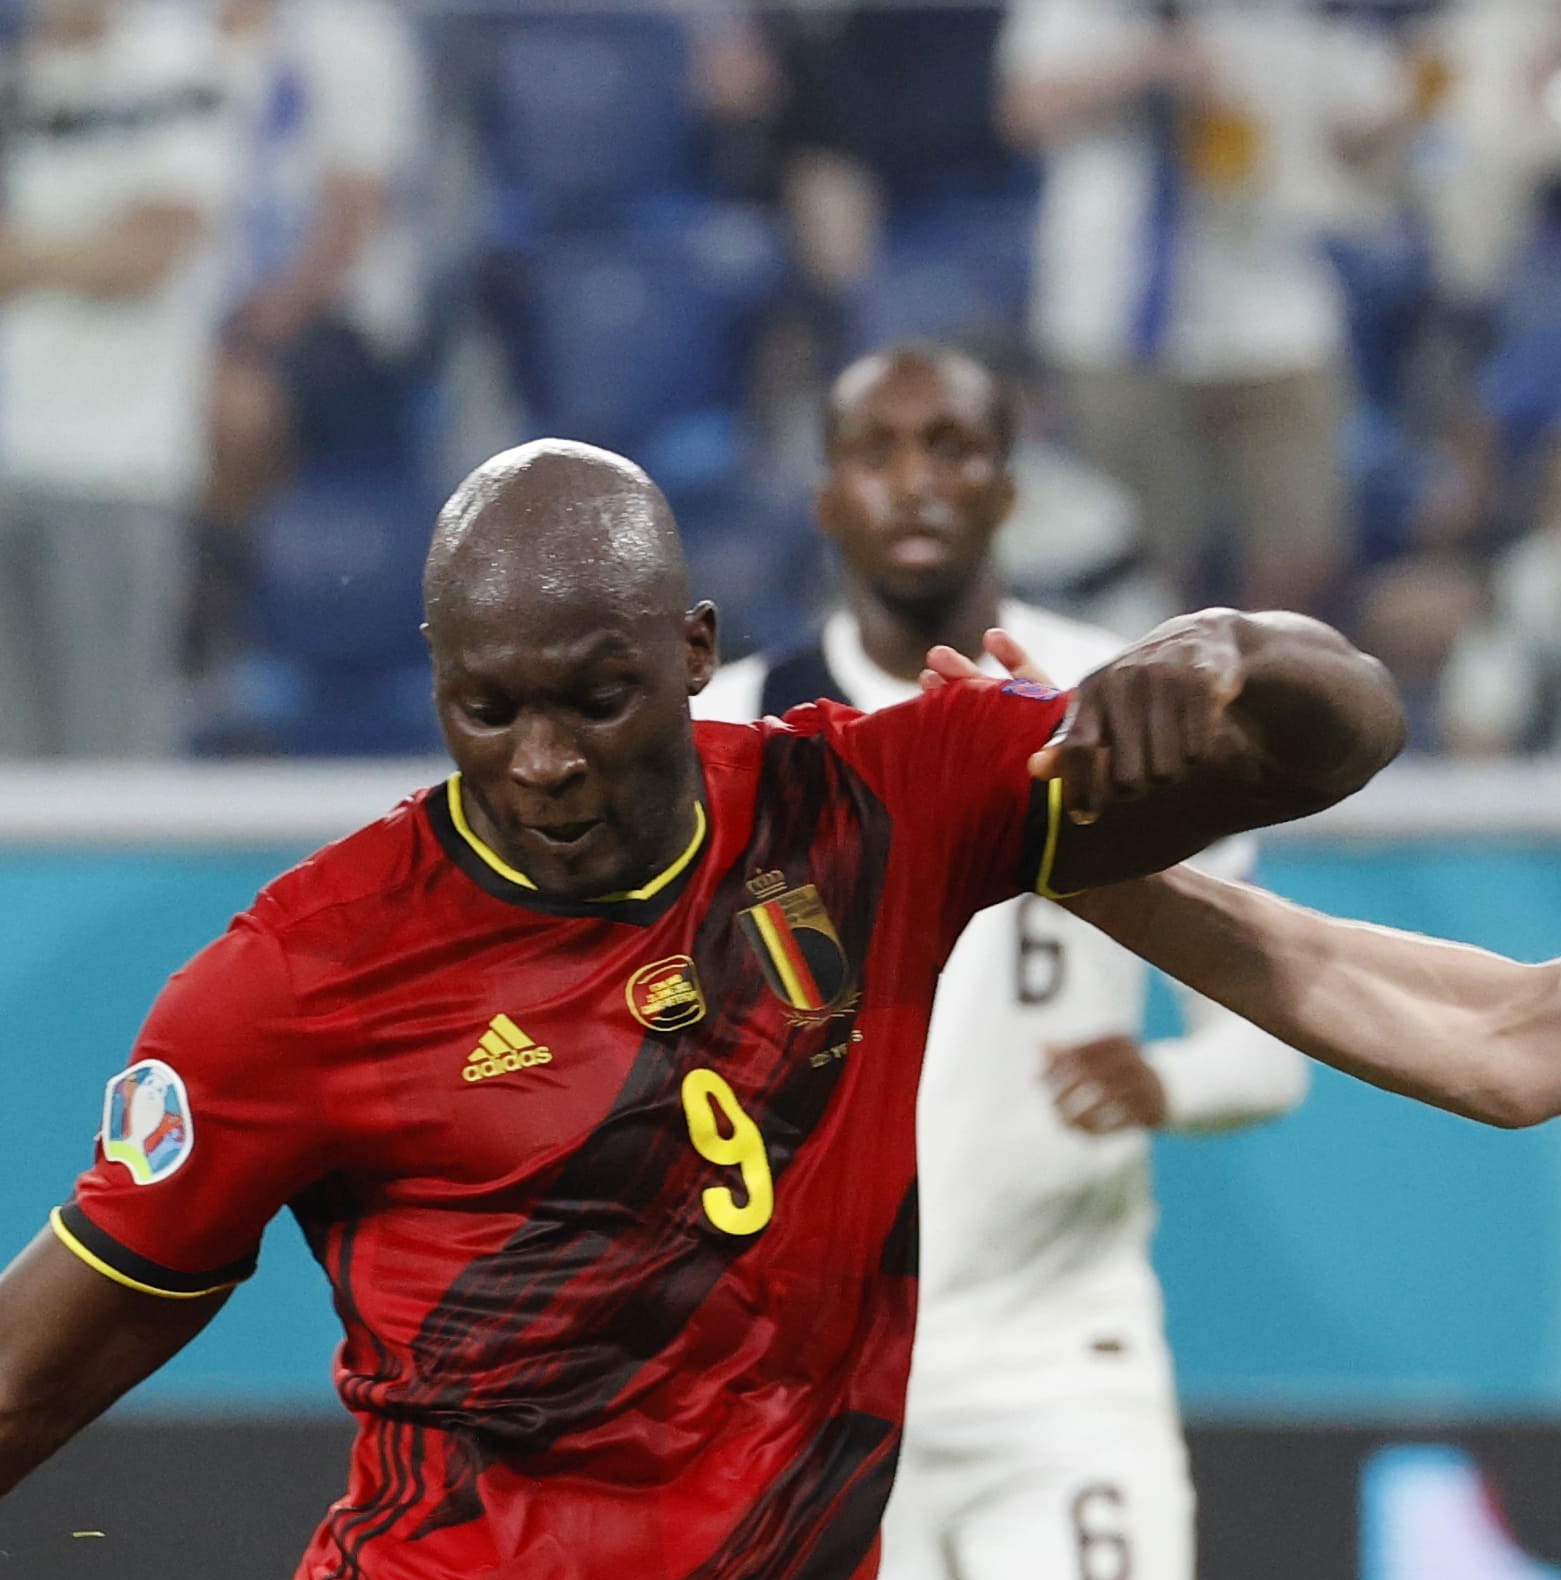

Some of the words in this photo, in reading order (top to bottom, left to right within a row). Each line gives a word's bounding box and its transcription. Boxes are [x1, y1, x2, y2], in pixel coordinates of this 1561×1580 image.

[1014, 892, 1068, 1006] 6
[461, 1045, 553, 1083] adidas
[681, 1067, 774, 1236] 9
